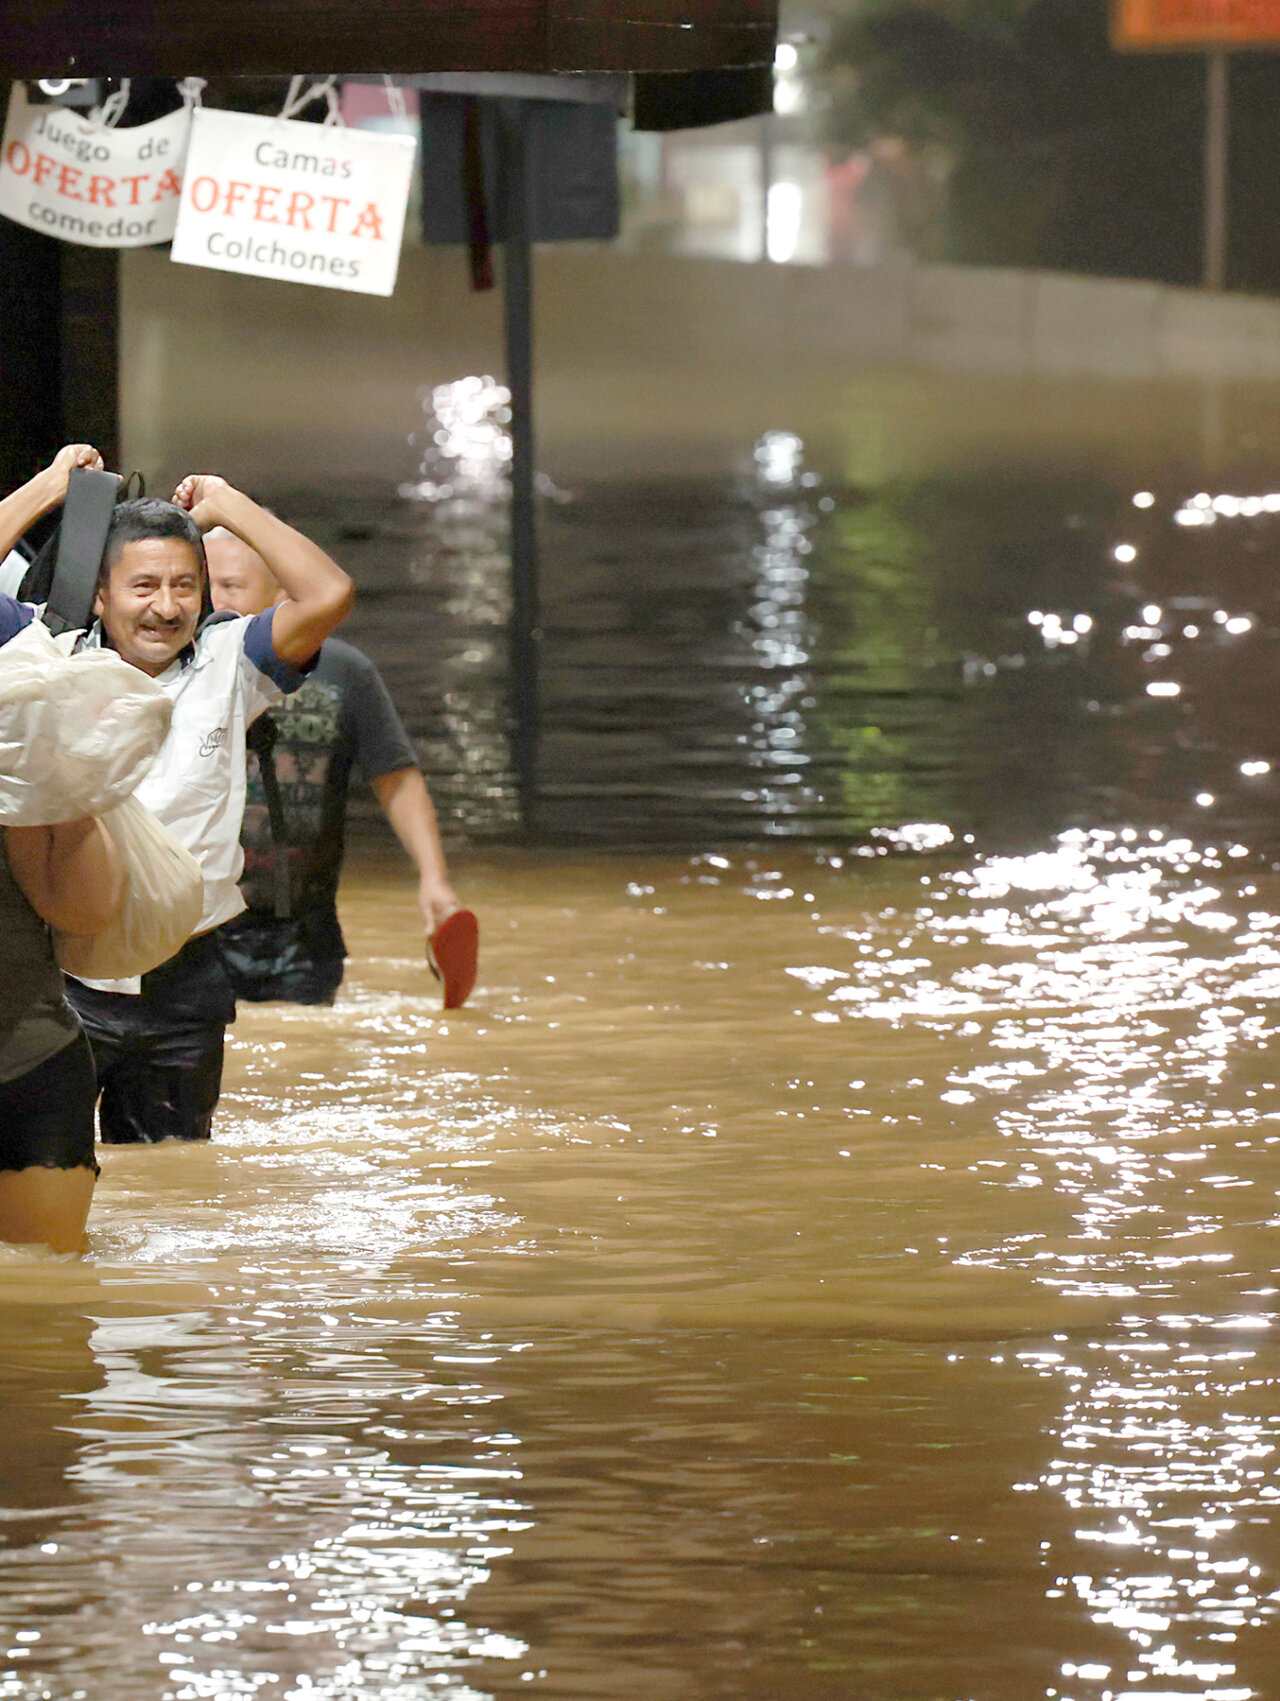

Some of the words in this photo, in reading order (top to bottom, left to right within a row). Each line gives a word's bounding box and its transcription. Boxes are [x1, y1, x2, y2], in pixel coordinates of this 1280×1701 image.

[36, 113, 110, 162] Juego
[138, 136, 171, 161] de
[254, 141, 352, 179] Camas
[7, 139, 182, 208] OFERTA
[191, 176, 384, 240] OFERTA
[207, 232, 361, 278] Colchones
